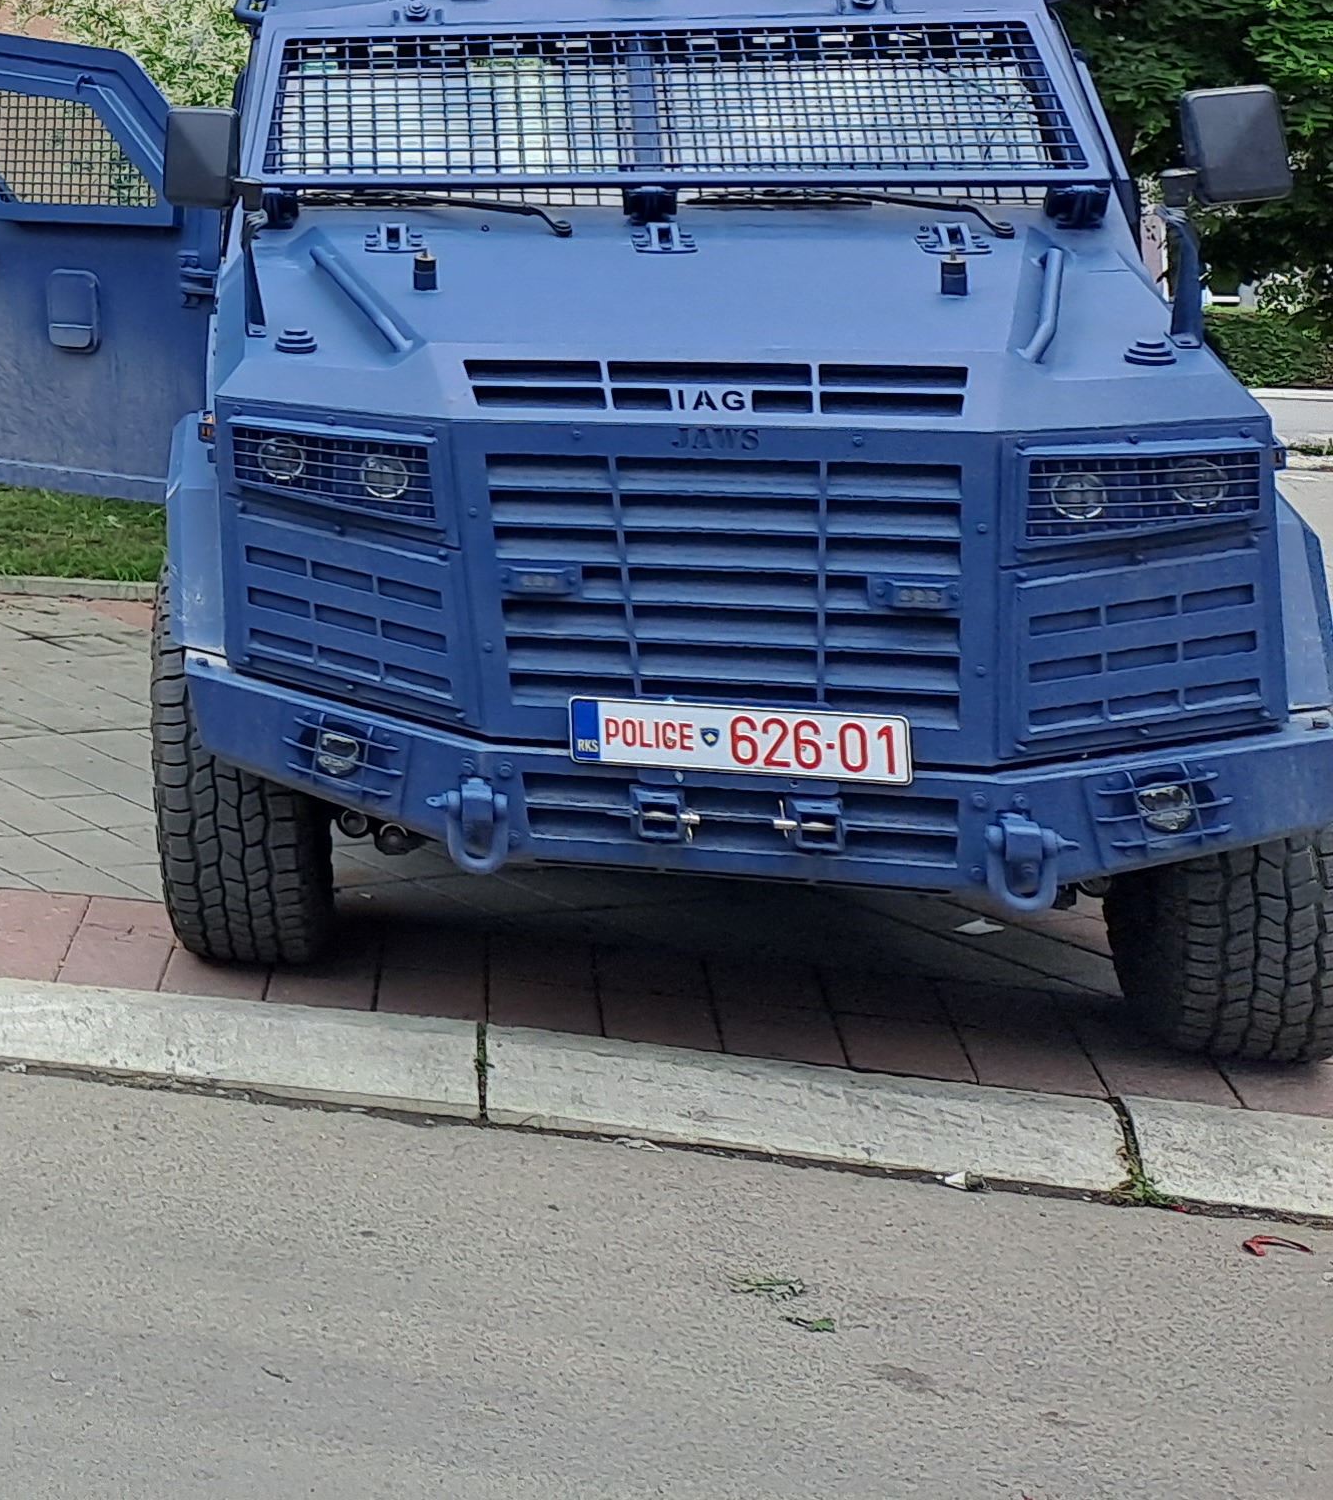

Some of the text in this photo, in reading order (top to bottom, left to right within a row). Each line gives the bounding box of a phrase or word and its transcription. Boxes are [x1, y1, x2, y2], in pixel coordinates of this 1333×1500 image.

[677, 389, 746, 411] IAG
[672, 426, 760, 451] JAWS
[577, 738, 600, 753] RKS
[604, 715, 897, 776] POLICE 626-01
